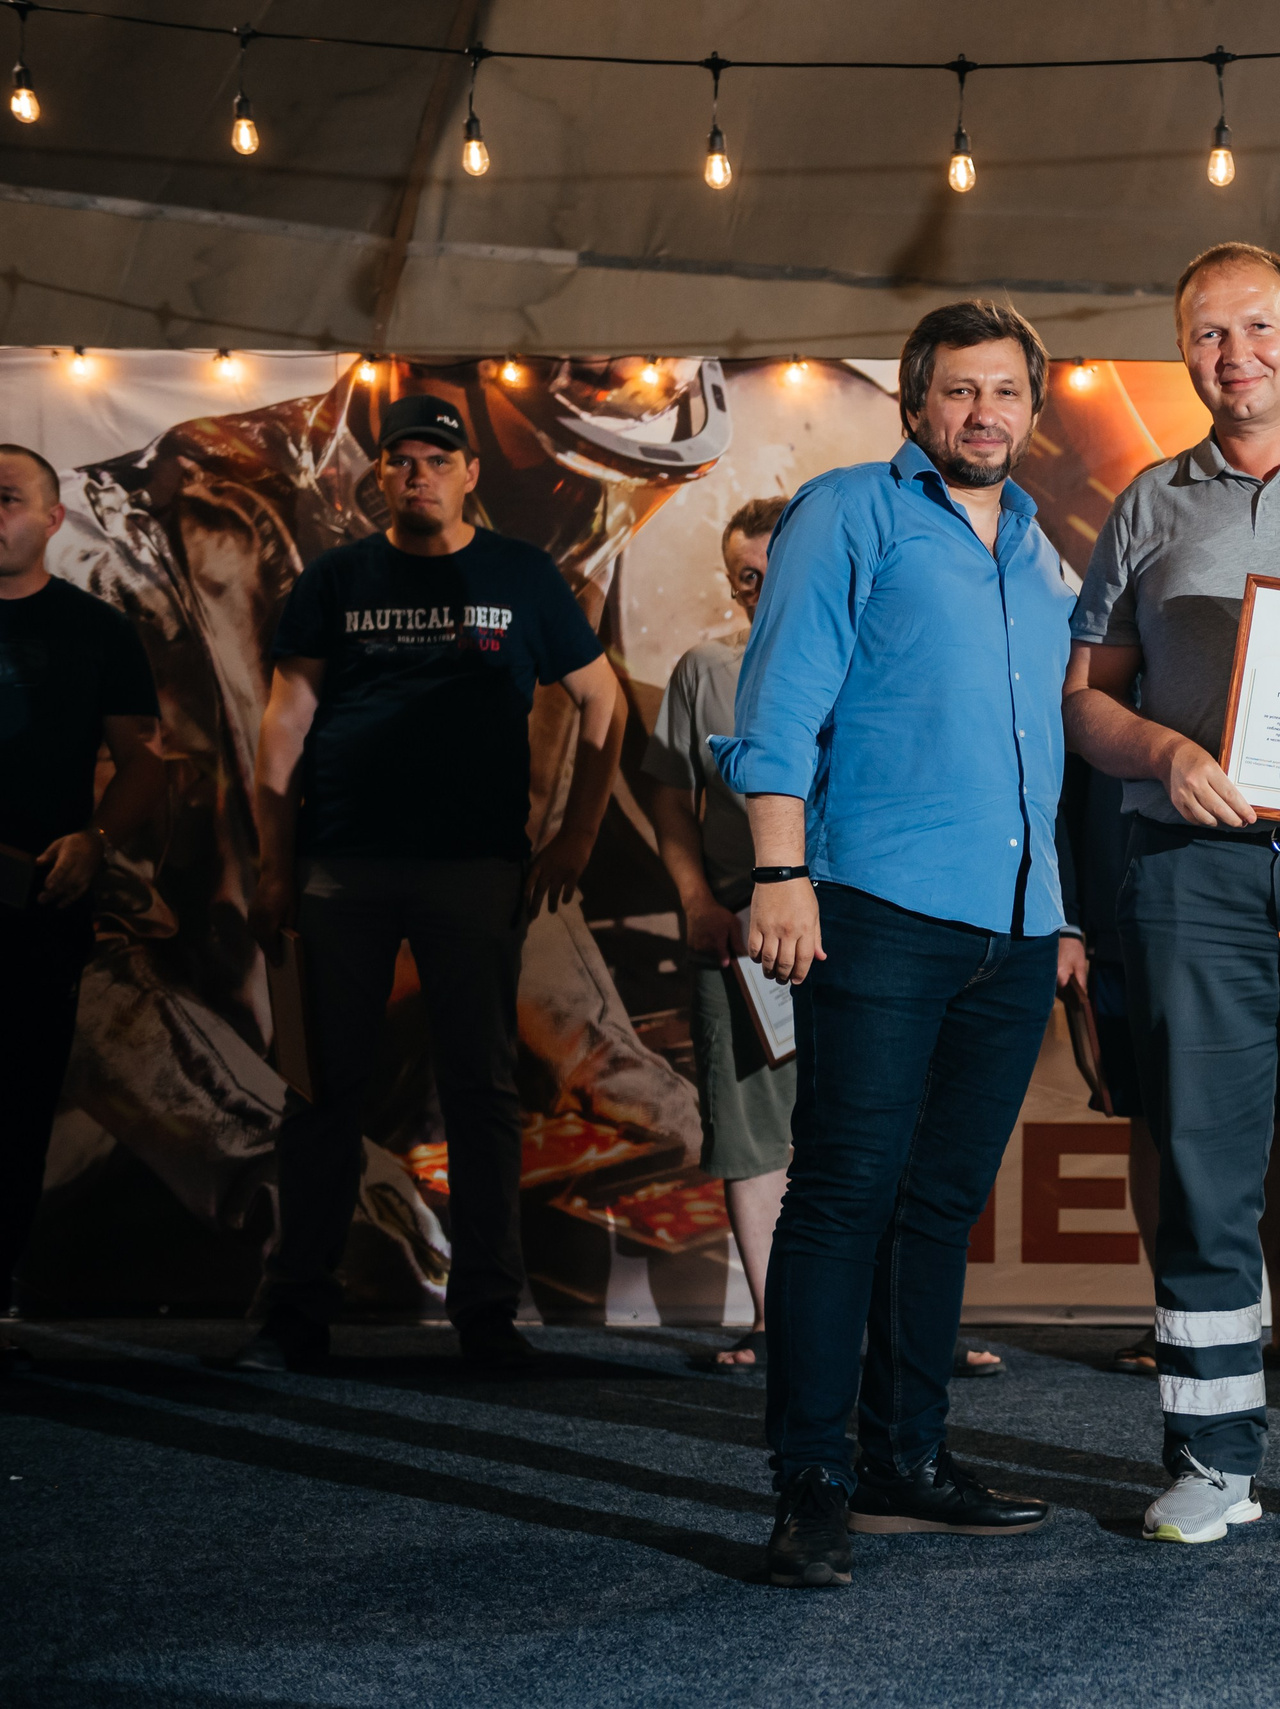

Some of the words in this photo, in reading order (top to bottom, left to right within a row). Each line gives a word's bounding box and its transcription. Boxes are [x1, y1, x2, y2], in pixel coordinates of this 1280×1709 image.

[436, 414, 459, 429] FILA
[345, 606, 454, 632] NAUTICAL
[463, 605, 512, 631] DEEP
